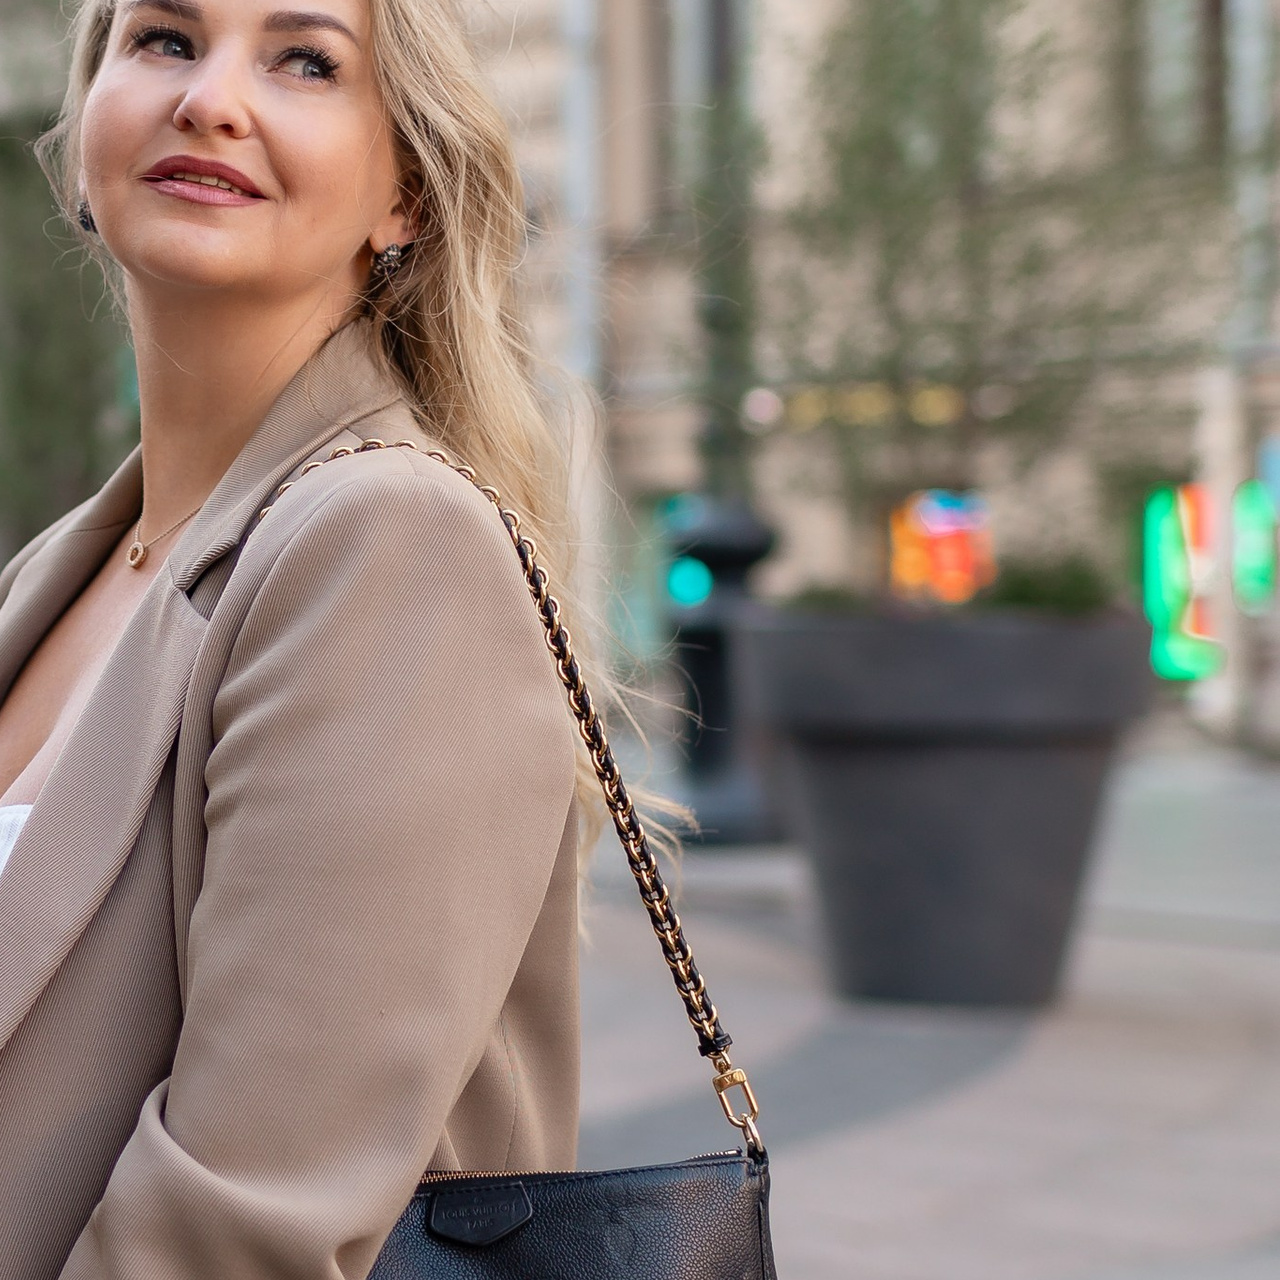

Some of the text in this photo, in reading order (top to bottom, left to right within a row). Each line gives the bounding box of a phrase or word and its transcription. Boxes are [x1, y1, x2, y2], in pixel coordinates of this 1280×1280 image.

[442, 1202, 517, 1220] LOUIS VUITTON
[467, 1219, 495, 1230] PARIS
